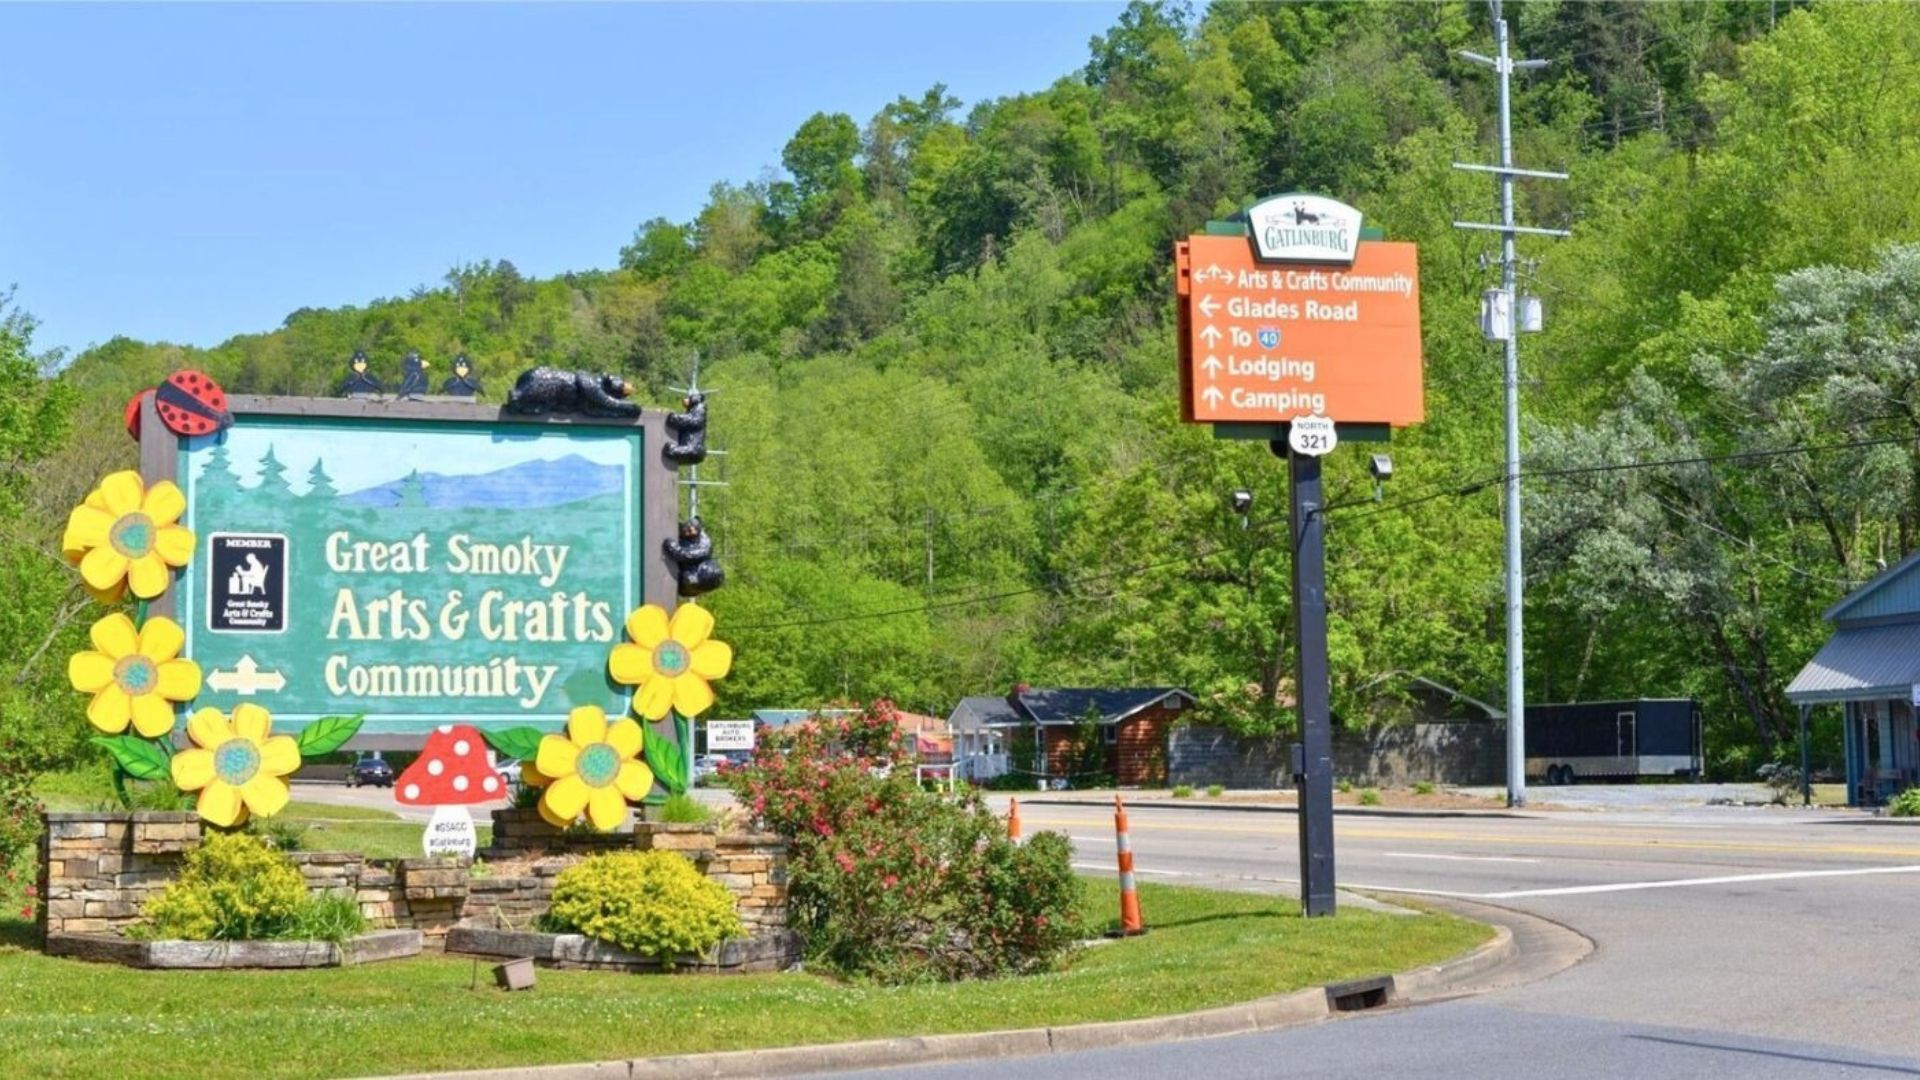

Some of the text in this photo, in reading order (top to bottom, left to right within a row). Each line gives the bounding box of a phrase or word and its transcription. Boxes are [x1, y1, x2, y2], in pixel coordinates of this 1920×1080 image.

[1265, 226, 1348, 252] GATLINBURG
[1237, 270, 1412, 297] Arts & Crafts Community
[1227, 297, 1358, 321] Glades Road
[1228, 326, 1277, 347] To 40
[1228, 355, 1315, 381] Lodging
[1230, 387, 1325, 414] Camping
[1297, 422, 1329, 430] NORTH
[1300, 434, 1328, 449] 321
[225, 539, 272, 548] MEMBER
[325, 531, 570, 588] Great Smoky
[326, 588, 614, 642] Arts & Crafts
[324, 654, 559, 709] Community
